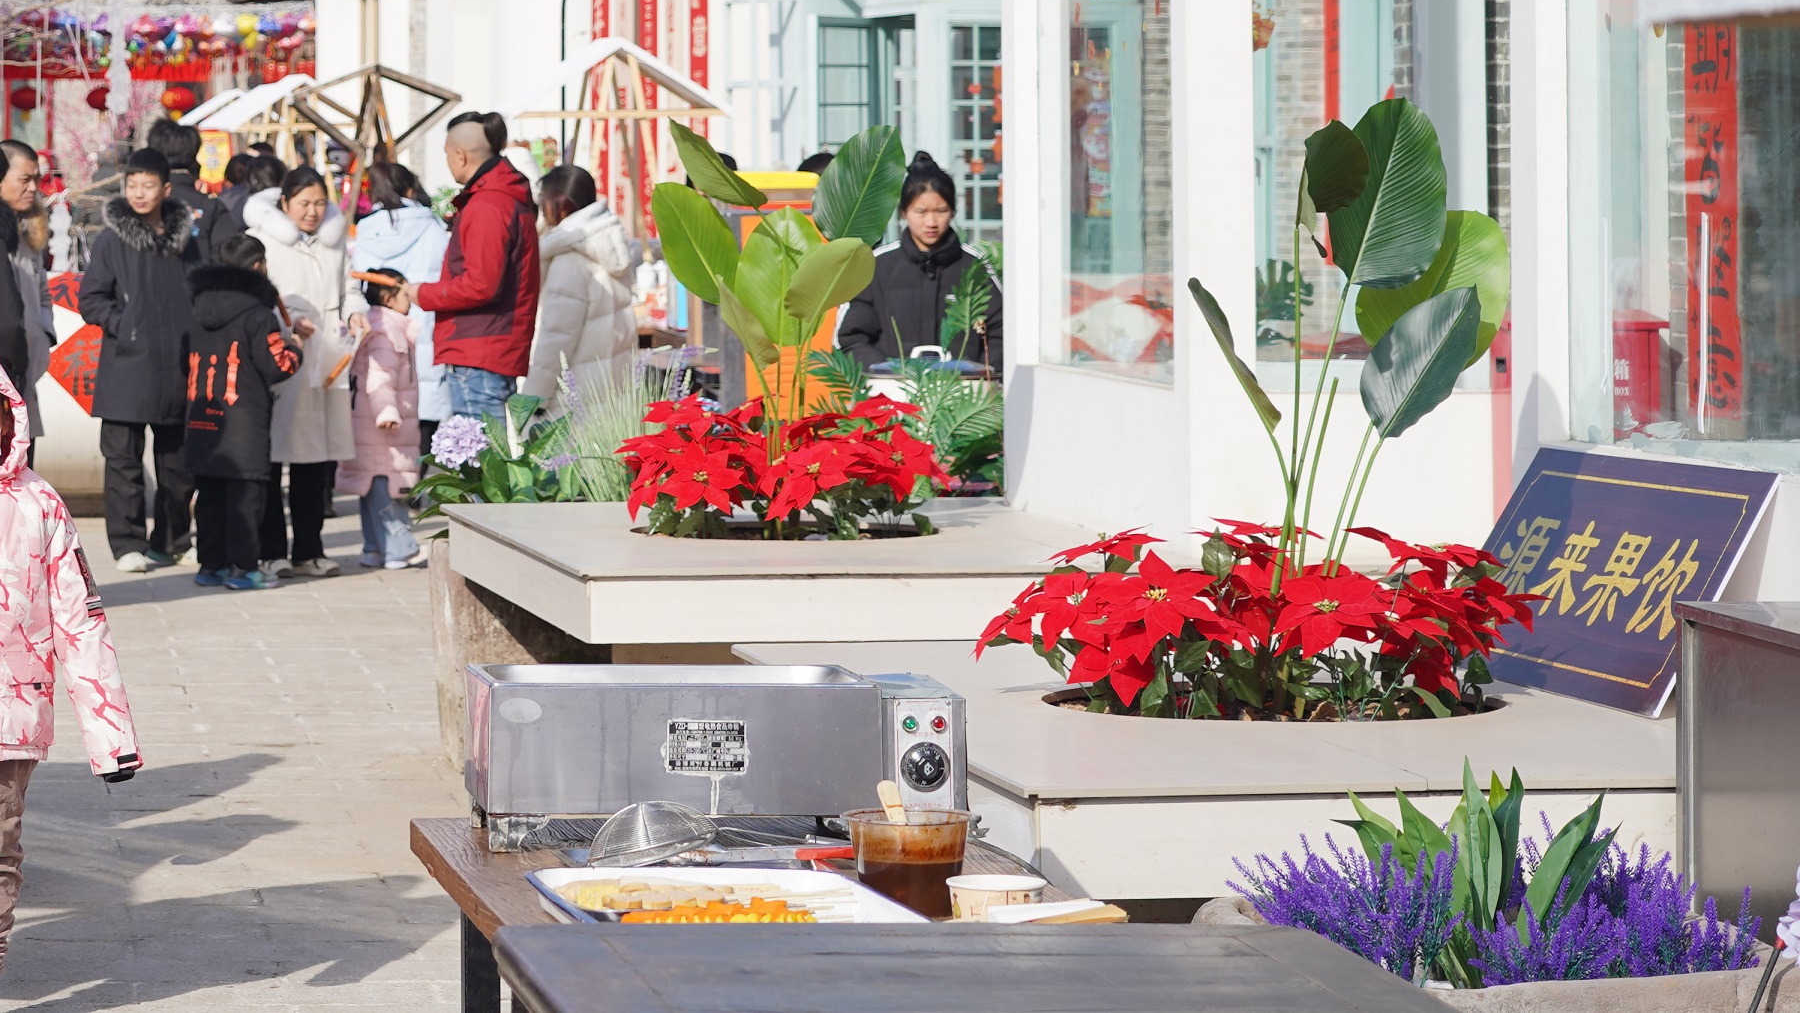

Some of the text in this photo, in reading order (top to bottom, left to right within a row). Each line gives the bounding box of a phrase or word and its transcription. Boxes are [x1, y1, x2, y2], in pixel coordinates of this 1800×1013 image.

[1613, 358, 1630, 381] 箱
[1614, 386, 1630, 397] BOX
[1493, 515, 1701, 641] 源来果饮
